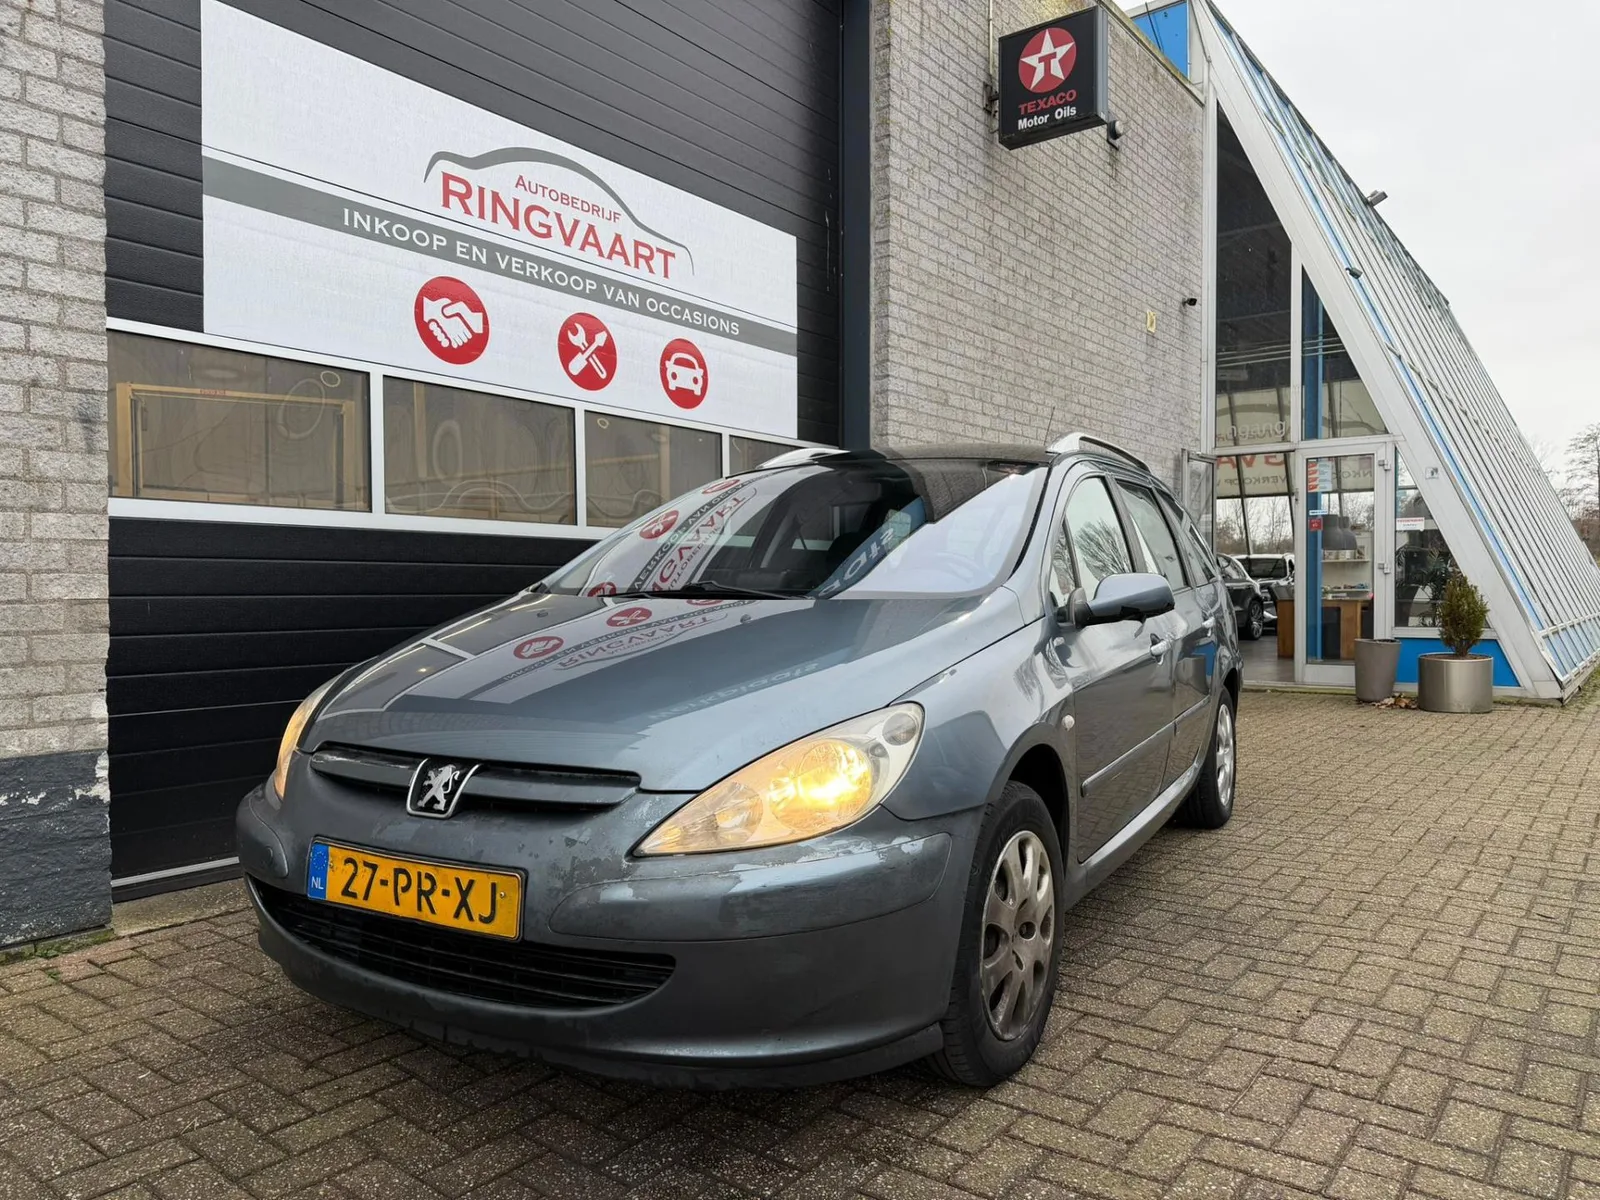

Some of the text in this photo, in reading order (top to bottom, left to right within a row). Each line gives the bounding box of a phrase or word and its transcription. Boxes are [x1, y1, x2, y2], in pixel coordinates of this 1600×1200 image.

[1018, 89, 1077, 115] TEXACO
[1018, 106, 1077, 130] Motor Oils
[514, 174, 622, 224] AUTOBEDRIJF
[441, 170, 676, 280] RINGVAART
[343, 207, 740, 336] INKOOP EN VERKOOP VAN OCCASIONS
[311, 876, 324, 890] NL
[341, 857, 497, 924] 27-PR-XJ
